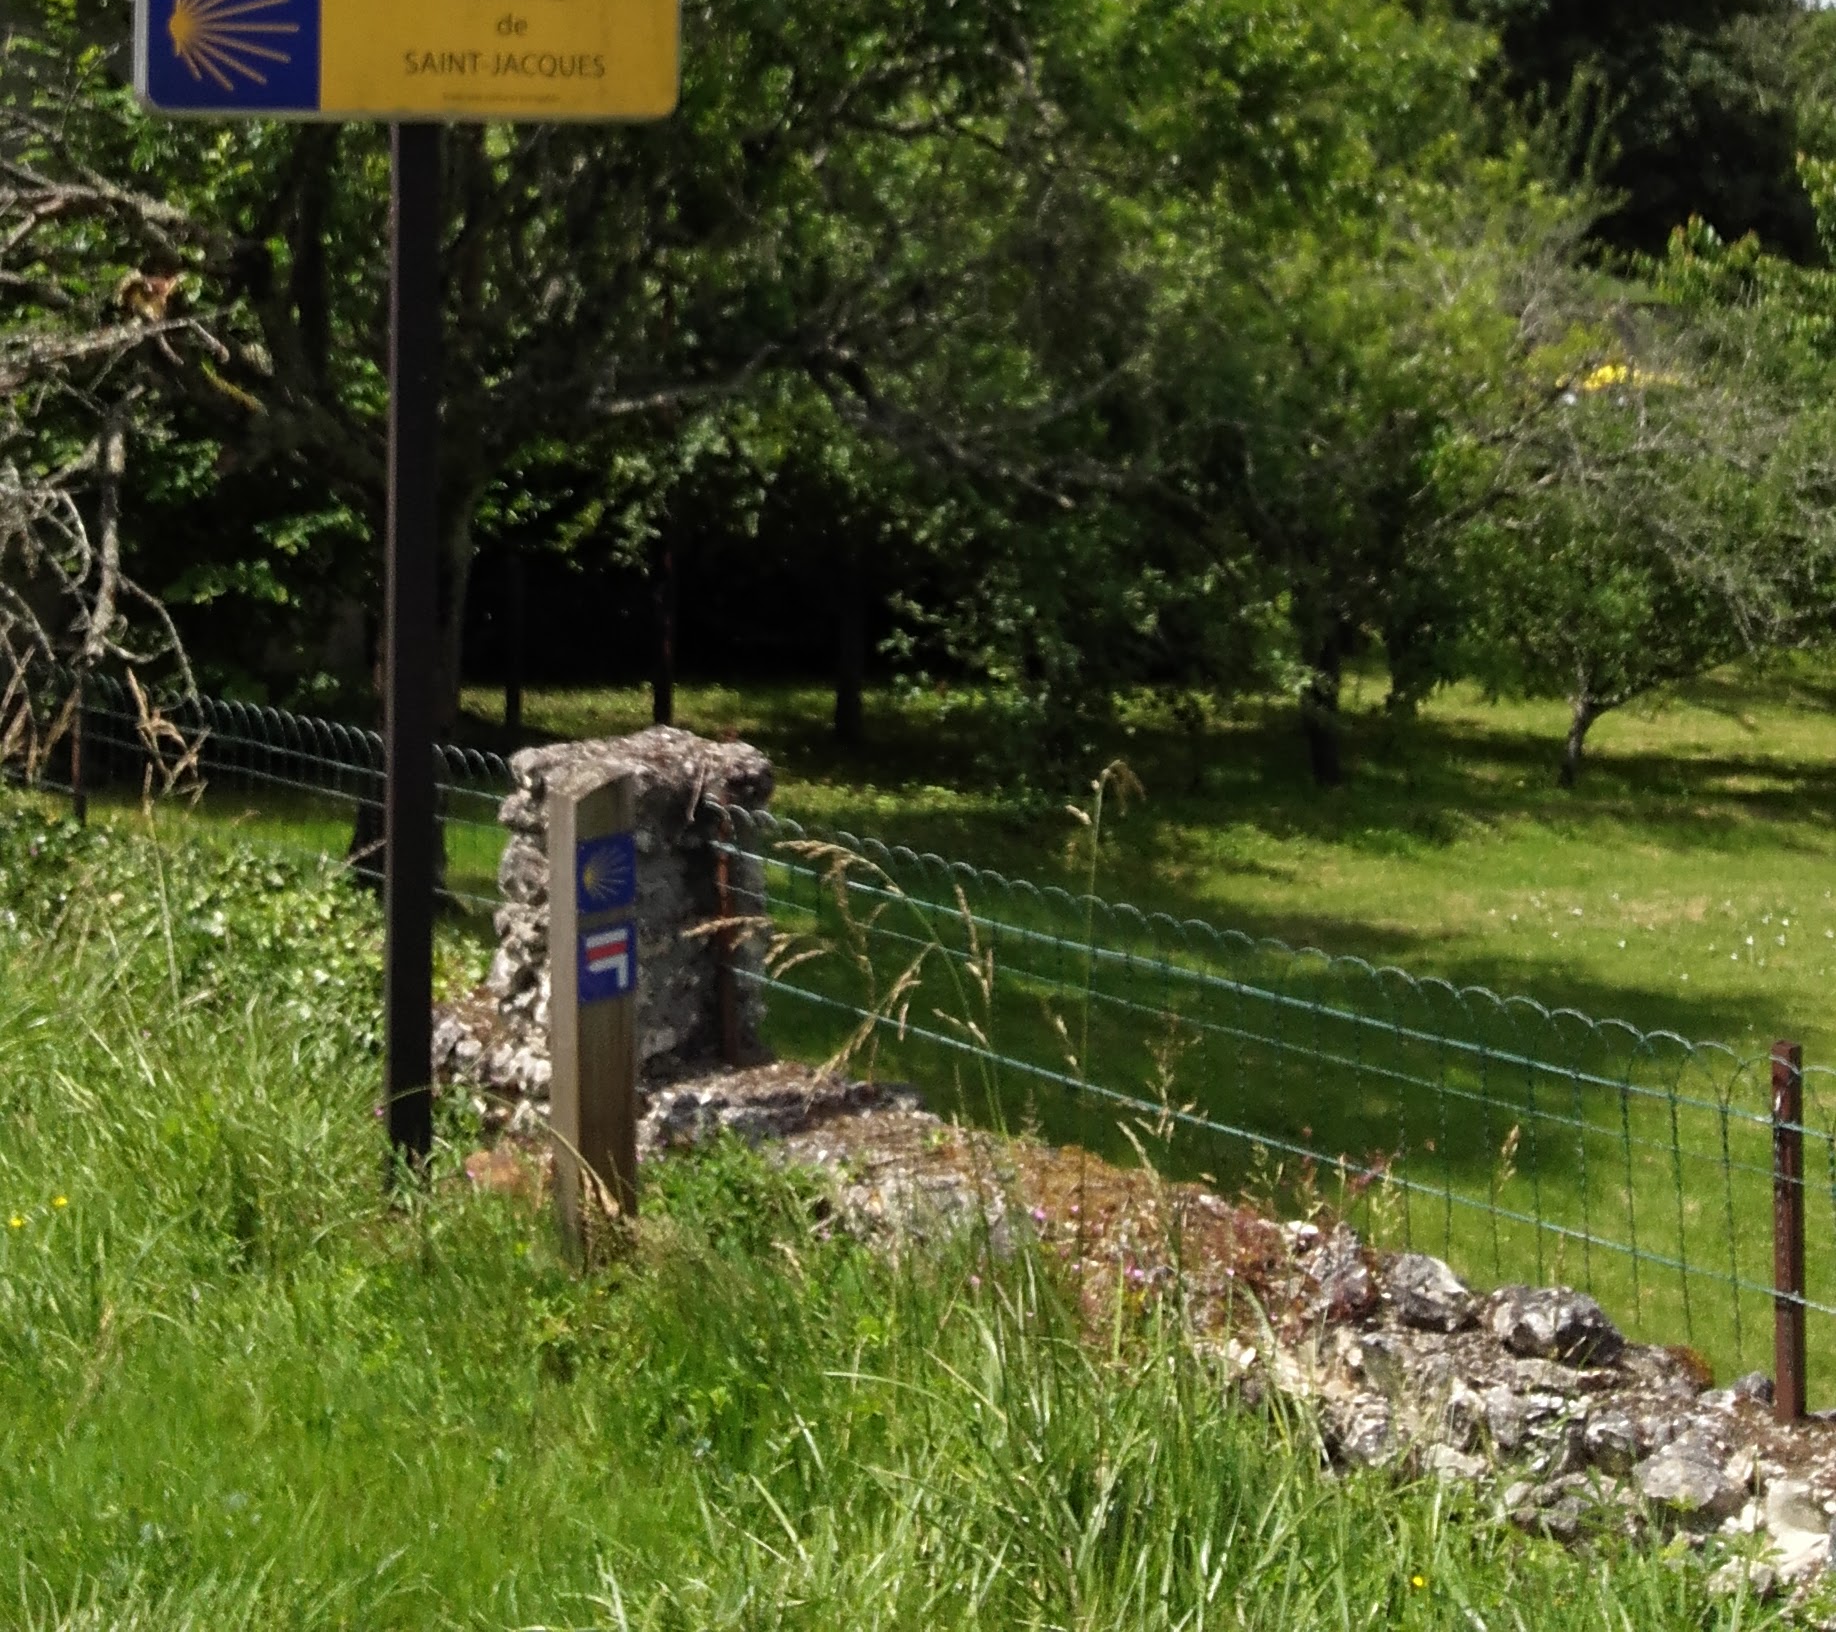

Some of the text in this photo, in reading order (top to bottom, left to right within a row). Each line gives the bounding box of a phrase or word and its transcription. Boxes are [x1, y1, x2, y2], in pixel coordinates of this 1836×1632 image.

[497, 13, 528, 35] de
[404, 50, 605, 77] SAINT JACQUES
